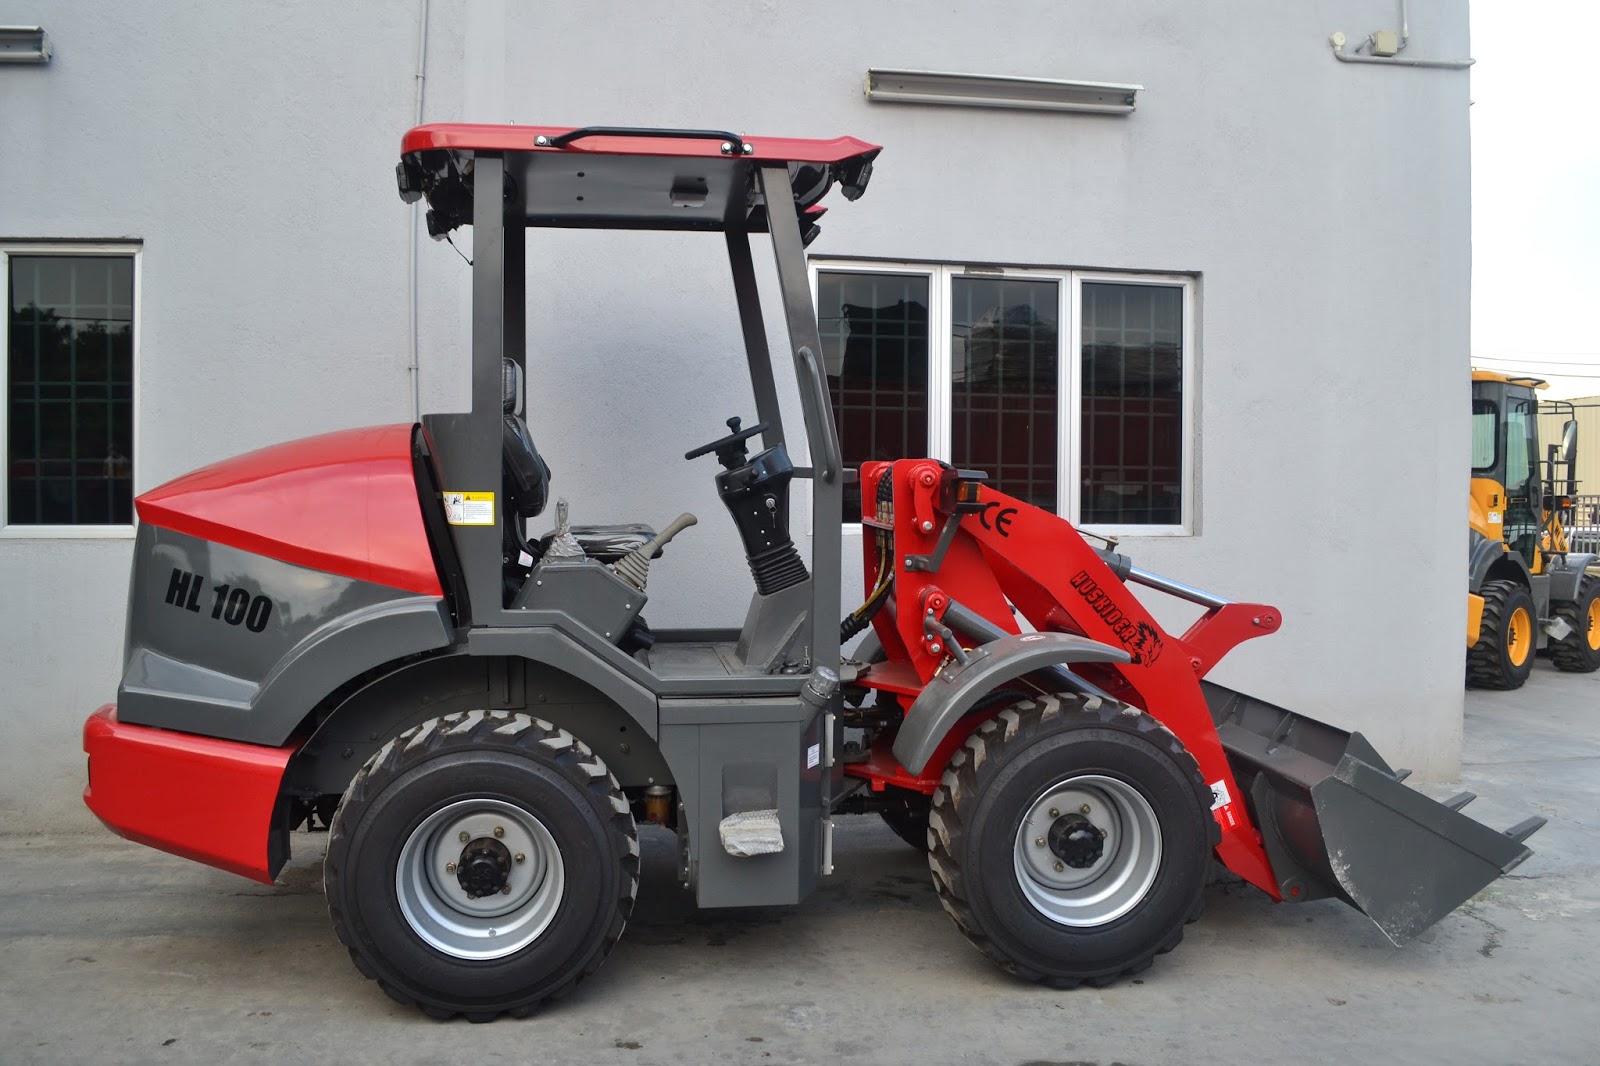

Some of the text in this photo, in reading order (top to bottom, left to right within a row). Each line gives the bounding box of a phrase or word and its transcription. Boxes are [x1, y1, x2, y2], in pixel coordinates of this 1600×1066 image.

[980, 501, 1018, 537] CE
[165, 567, 273, 633] HL 100
